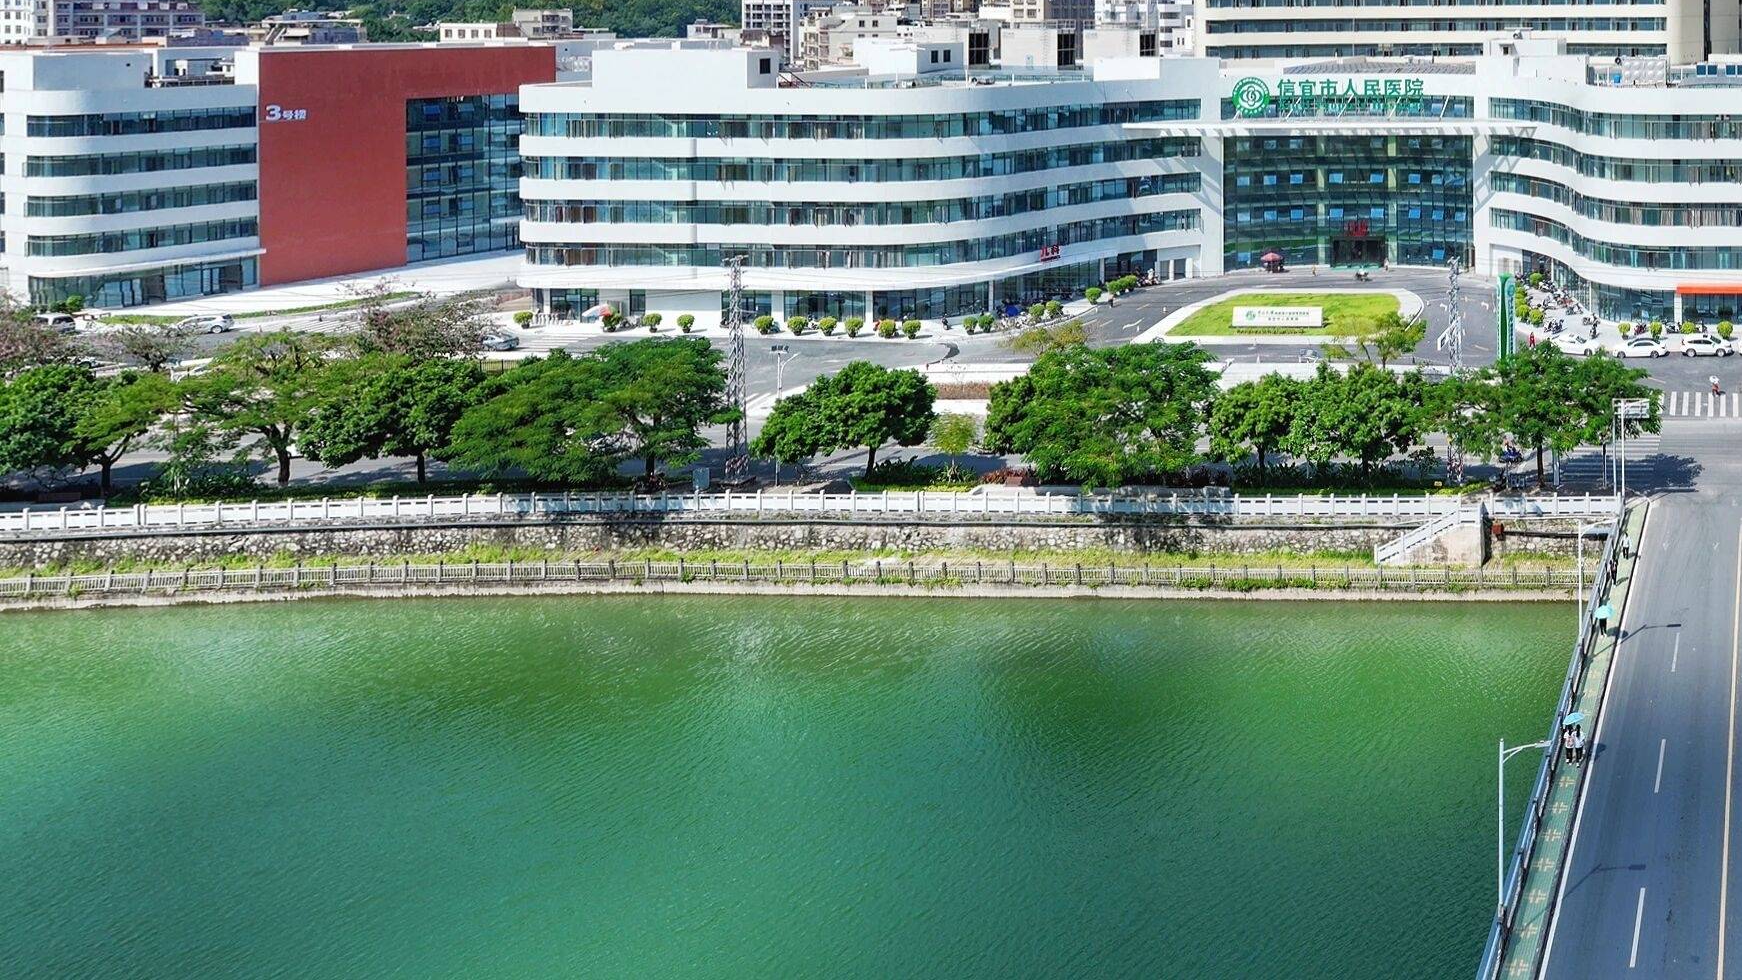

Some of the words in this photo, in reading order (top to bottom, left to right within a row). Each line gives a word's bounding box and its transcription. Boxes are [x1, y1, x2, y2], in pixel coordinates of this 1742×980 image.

[1277, 78, 1424, 98] 信宜市人民医院
